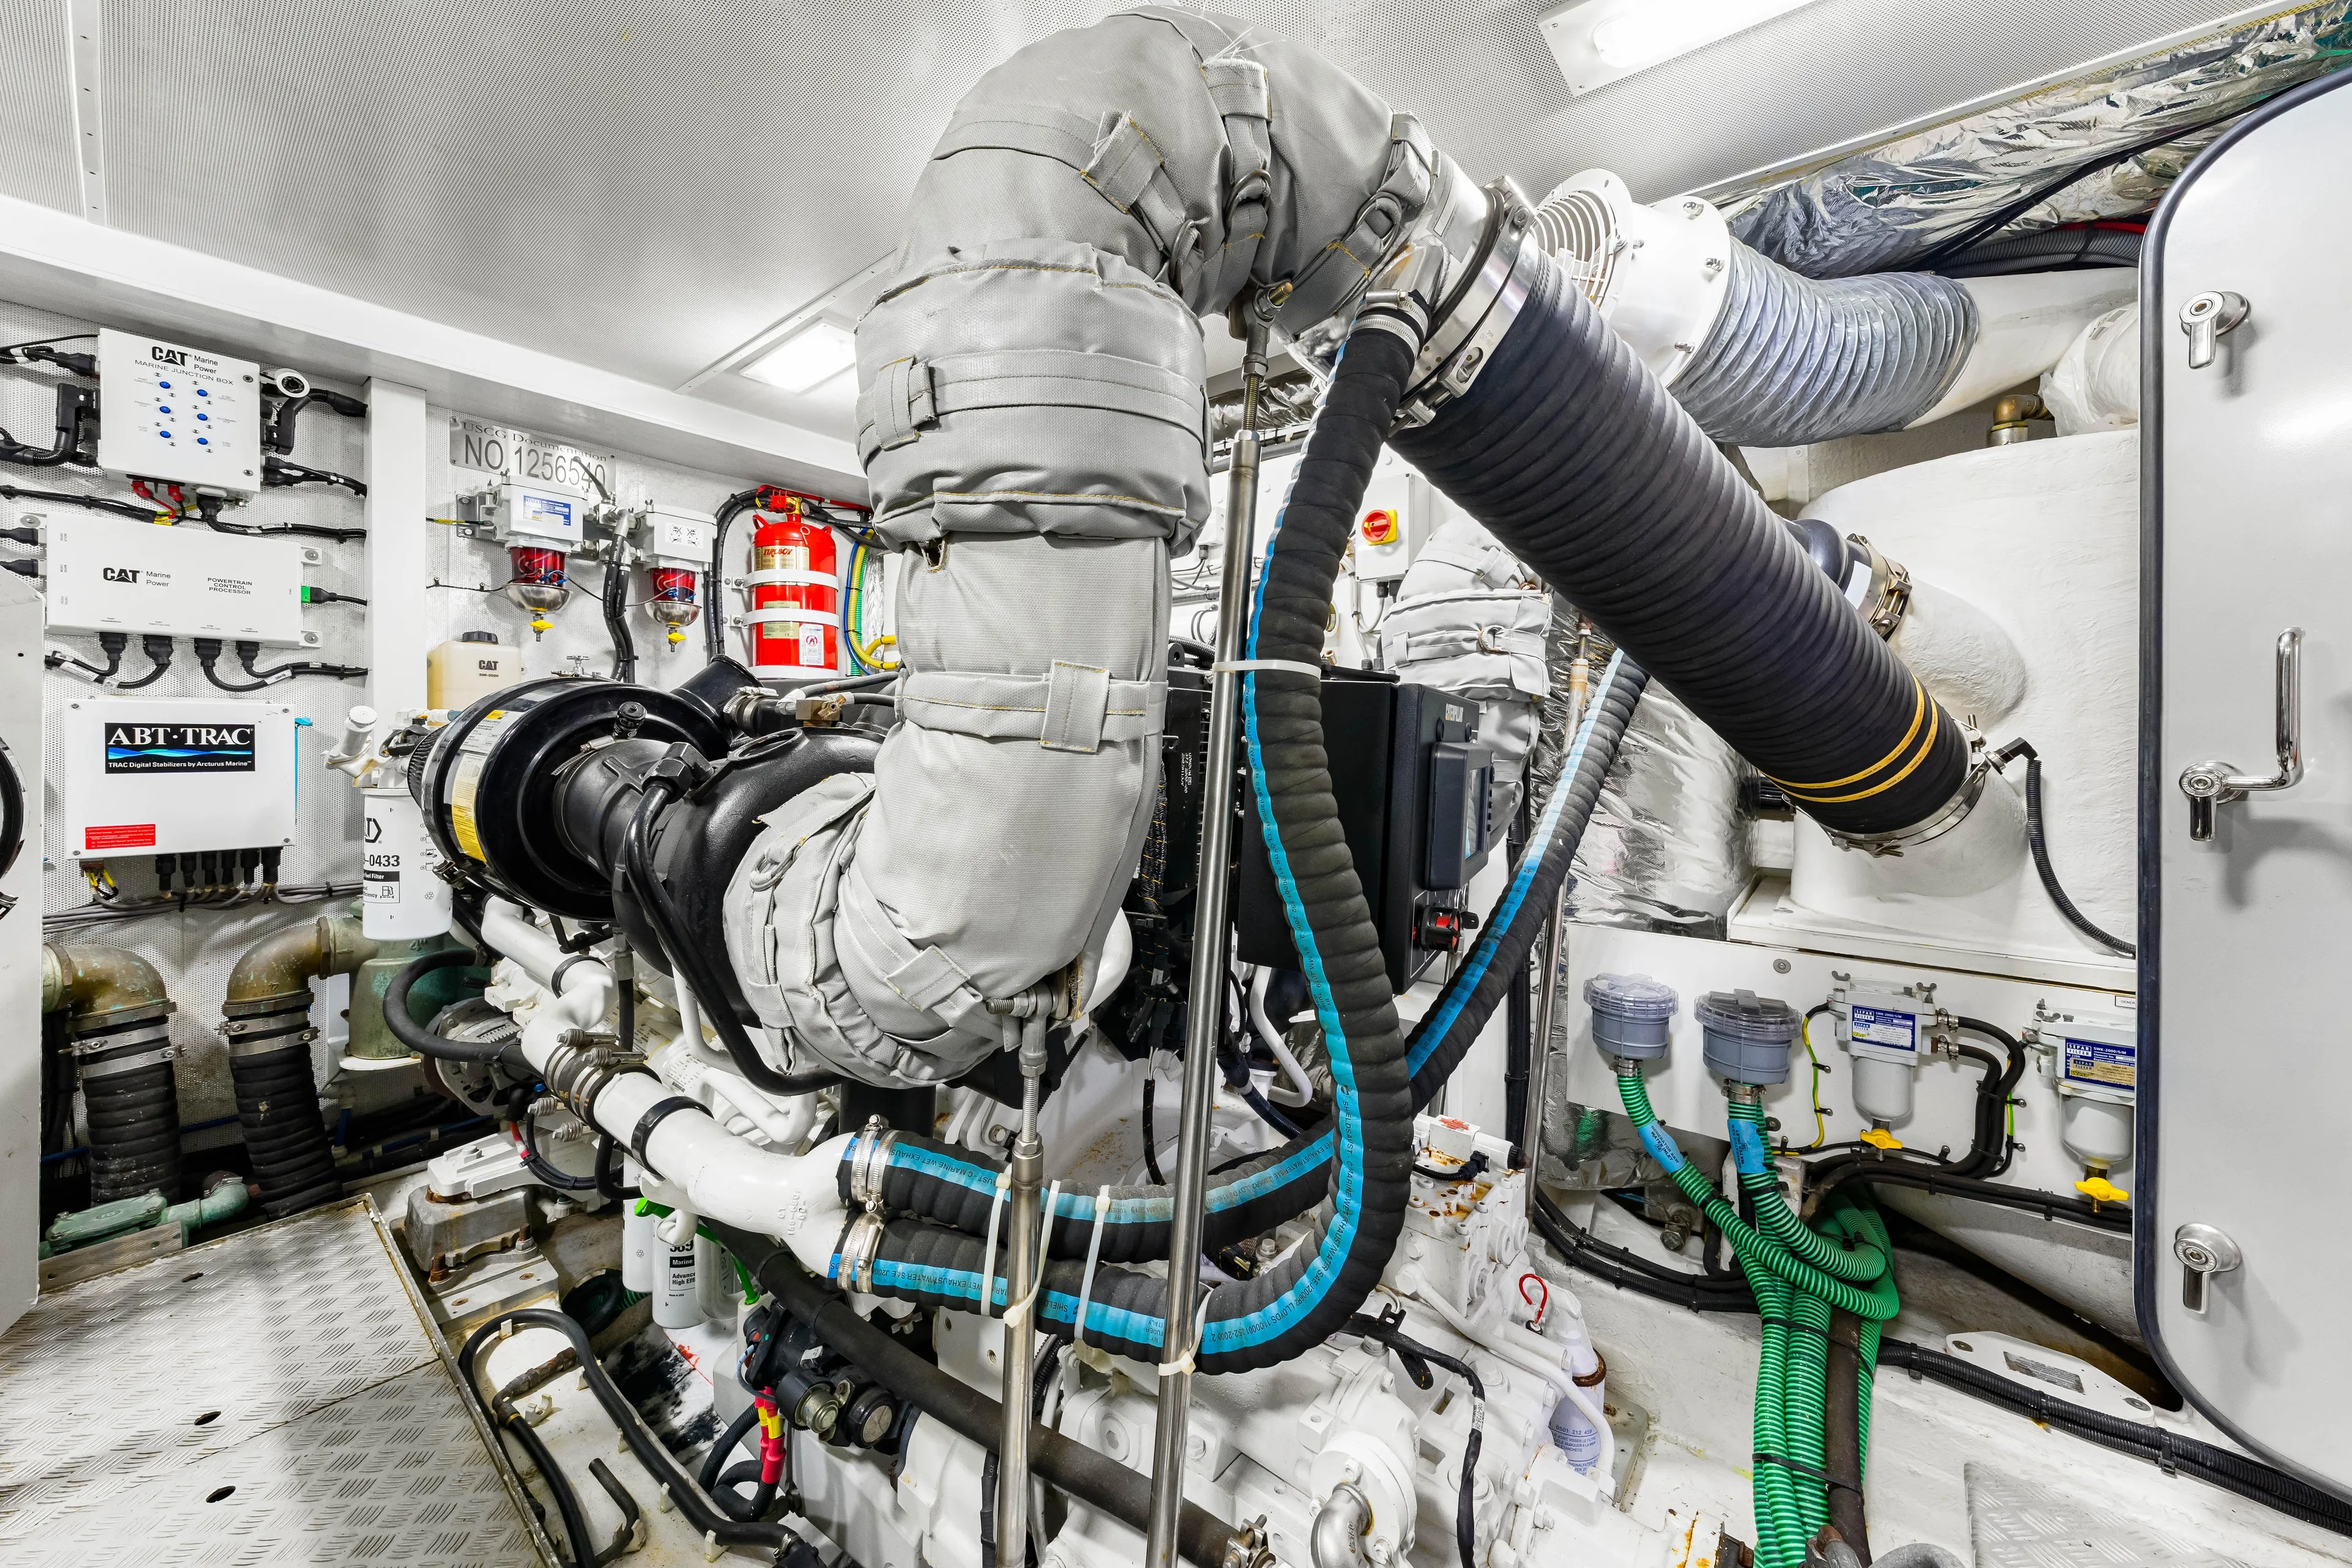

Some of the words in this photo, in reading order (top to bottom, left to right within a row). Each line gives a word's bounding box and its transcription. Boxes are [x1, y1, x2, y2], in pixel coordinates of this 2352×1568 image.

[152, 346, 188, 367] CAT
[194, 355, 218, 366] Marine
[135, 360, 169, 371] MARINE
[172, 368, 214, 380] JUNCTION
[194, 364, 217, 374] Power
[462, 422, 507, 439] USCG
[512, 432, 606, 462] Documentation
[466, 434, 503, 470] NO
[103, 567, 140, 584] CAT
[479, 660, 498, 670] CAT
[1267, 832, 1281, 865] LLOYDS
[1343, 1101, 1353, 1156] SHIELDSAUST
[1650, 1131, 1664, 1148] WATER
[1662, 1145, 1673, 1161] INLET
[1651, 1125, 1672, 1153] GENERATOR
[1671, 1150, 1679, 1164] RAW
[889, 1148, 920, 1161] EXHAUS
[921, 1156, 937, 1166] WET
[1286, 1147, 1324, 1174] EXHAUST/WATER
[938, 1161, 967, 1175] MARINE
[1275, 1170, 1286, 1180] SAE
[907, 1273, 967, 1287] EXHAUST/WATER
[1314, 1269, 1324, 1286] SAE
[1295, 1283, 1315, 1307] J2006R2
[1271, 1302, 1295, 1324] LLOYDS
[1148, 1319, 1164, 1329] ITALY
